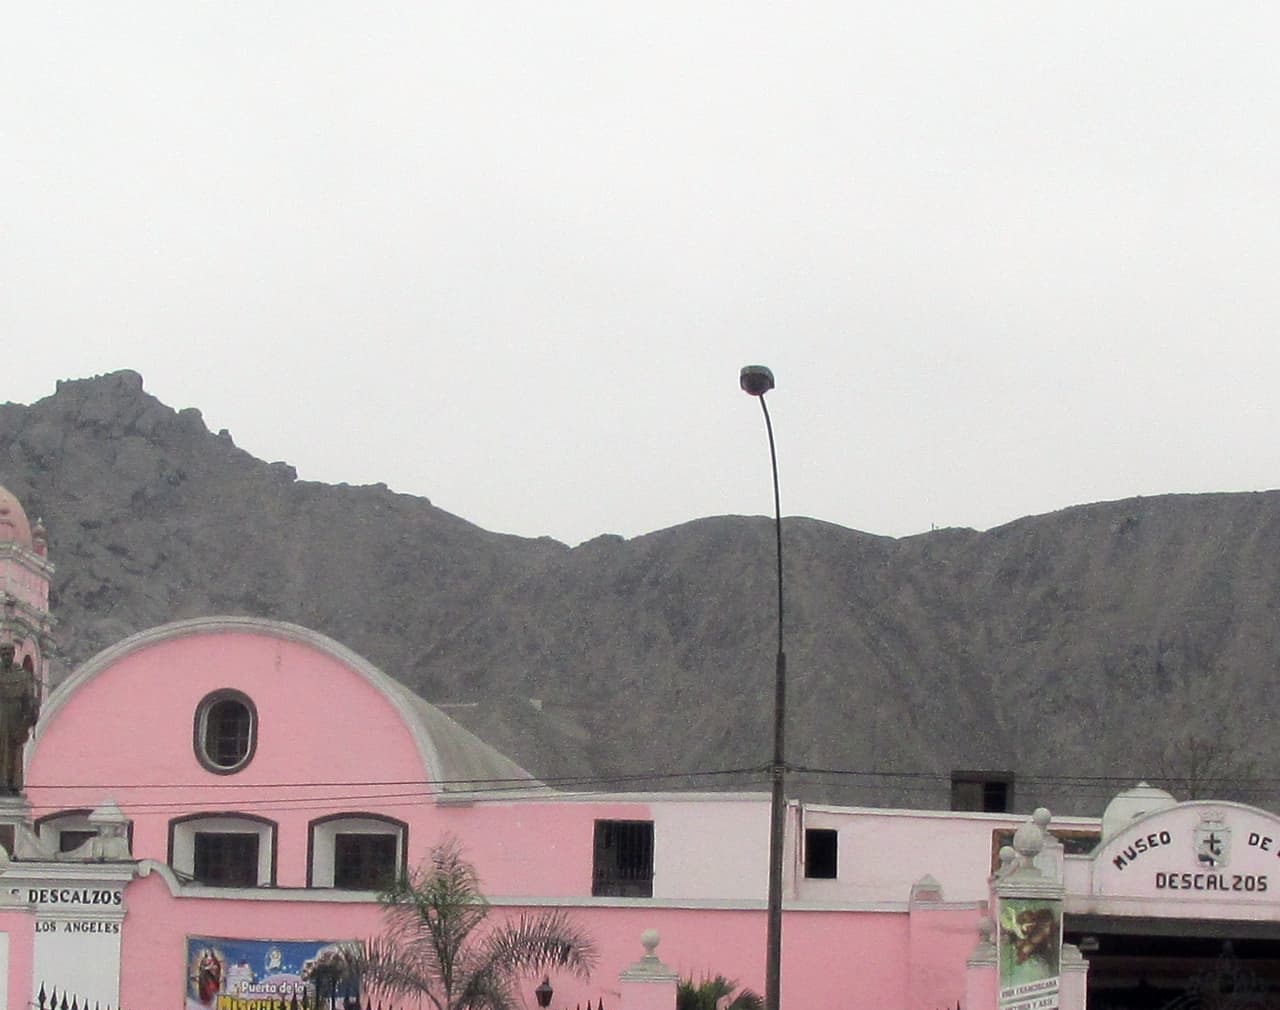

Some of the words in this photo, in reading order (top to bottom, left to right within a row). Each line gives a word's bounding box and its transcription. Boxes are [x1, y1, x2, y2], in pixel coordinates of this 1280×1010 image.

[1113, 830, 1172, 871] MUSEO
[1247, 832, 1273, 851] DE
[1155, 872, 1268, 892] DESCALZOS
[28, 888, 122, 906] DESCALZOS
[35, 921, 57, 933] LOS
[64, 922, 120, 934] ANGELES
[241, 981, 277, 994] Puerta
[280, 982, 292, 993] de
